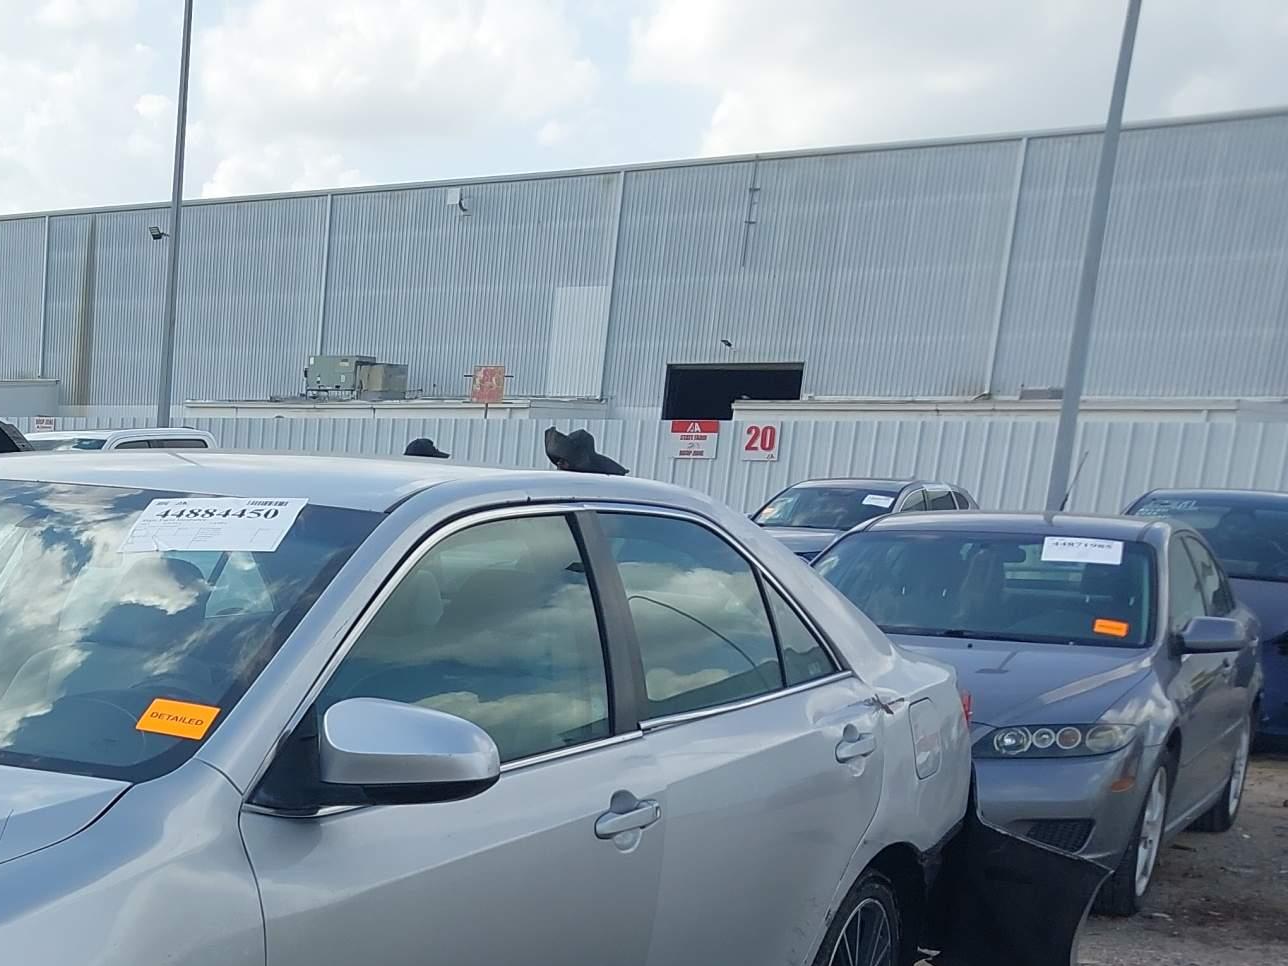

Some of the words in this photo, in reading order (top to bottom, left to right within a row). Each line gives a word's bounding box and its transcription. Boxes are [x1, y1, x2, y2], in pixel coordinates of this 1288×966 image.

[744, 425, 777, 451] 20
[155, 508, 280, 520] 44884450
[150, 711, 205, 727] DETAILED
